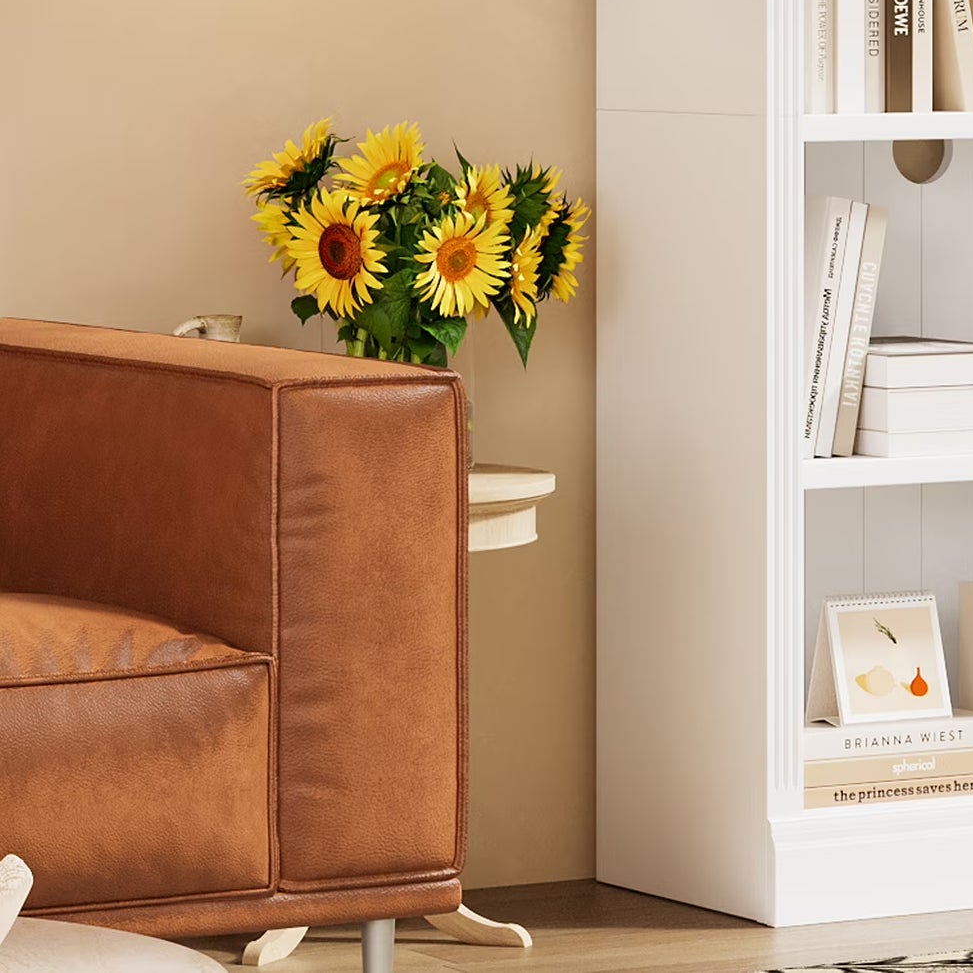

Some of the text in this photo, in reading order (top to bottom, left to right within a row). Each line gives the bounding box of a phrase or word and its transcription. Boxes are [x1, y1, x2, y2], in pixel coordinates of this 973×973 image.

[954, 0, 968, 31] RUM
[844, 730, 963, 749] BRIANNA WIEST
[834, 789, 856, 802] the
[858, 785, 914, 803] princess
[916, 783, 951, 796] saves
